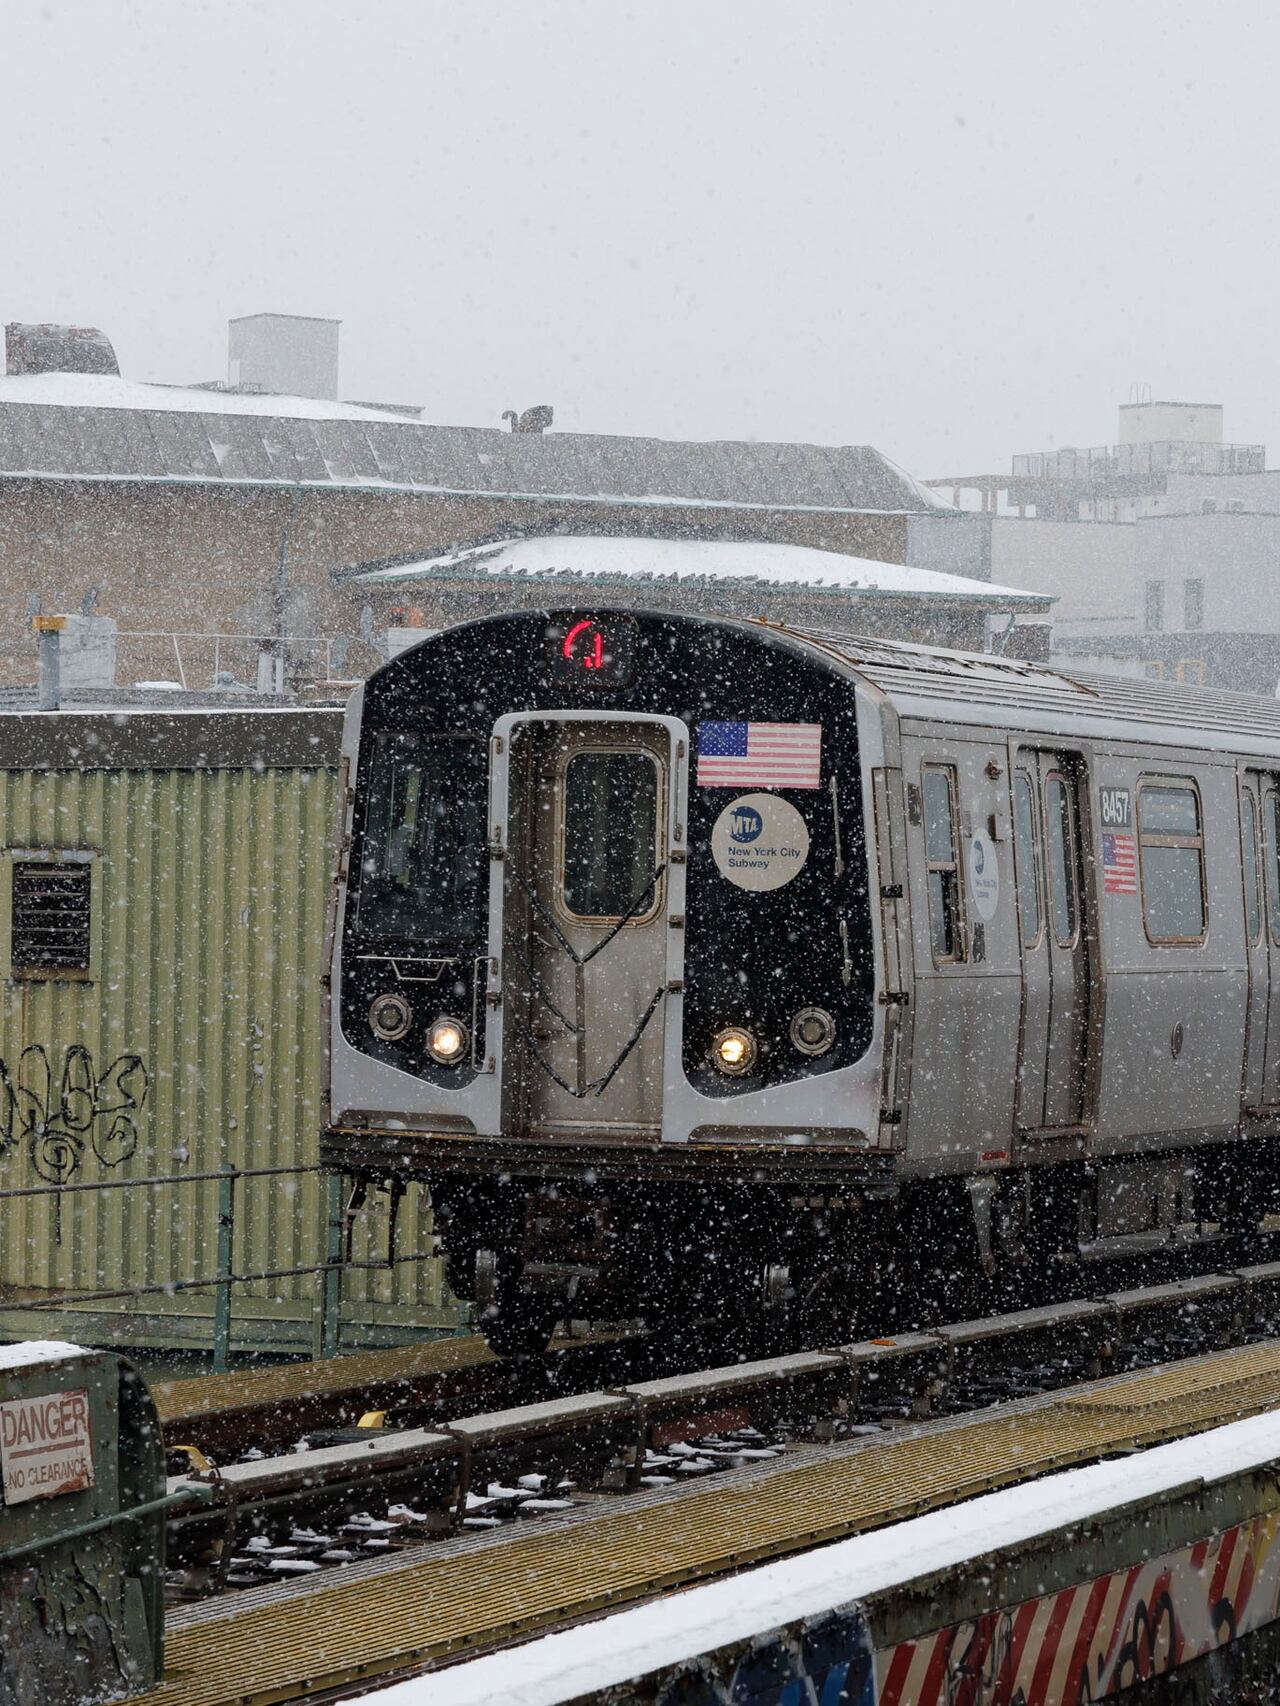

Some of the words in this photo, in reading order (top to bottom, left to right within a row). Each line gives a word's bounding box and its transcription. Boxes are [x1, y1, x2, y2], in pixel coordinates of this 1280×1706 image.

[1101, 790, 1130, 824] 8457
[730, 815, 759, 836] MTA
[728, 847, 750, 856] New
[754, 847, 777, 857] York
[780, 848, 801, 859] City
[728, 858, 770, 871] Subway
[0, 1397, 88, 1448] DANGER
[8, 1469, 26, 1490] NO
[28, 1457, 89, 1487] CLEARANCE
